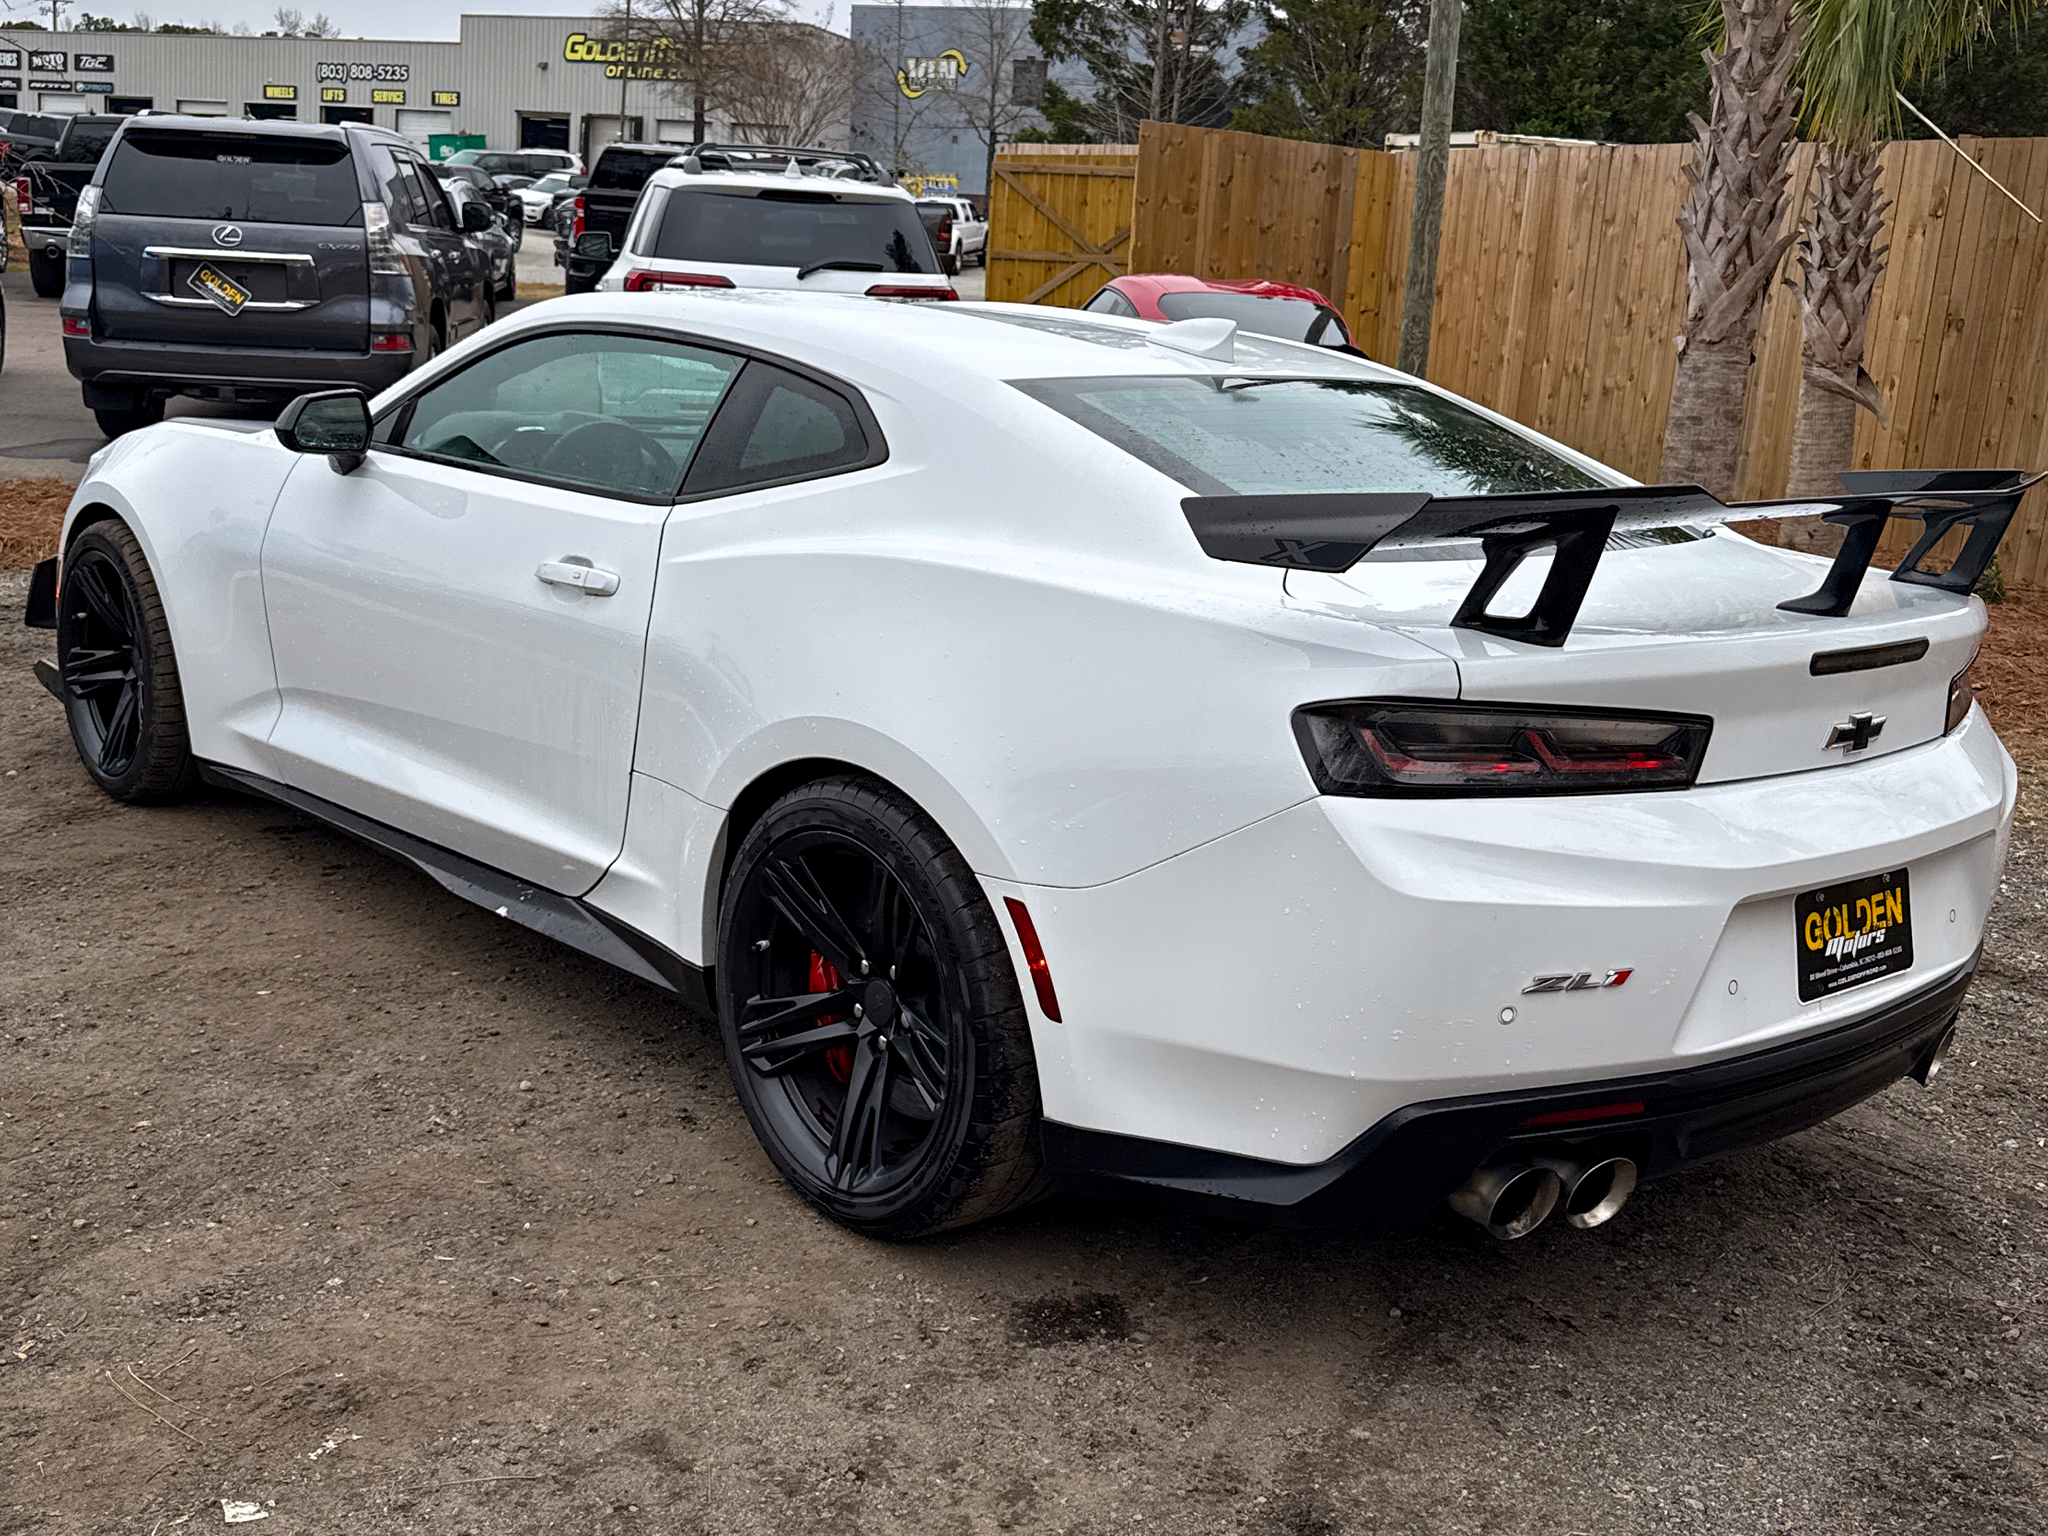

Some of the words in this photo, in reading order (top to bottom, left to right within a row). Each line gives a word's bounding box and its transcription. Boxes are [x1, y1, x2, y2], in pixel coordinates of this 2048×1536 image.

[317, 63, 348, 83] (803)
[350, 64, 409, 81] 808-5235
[266, 86, 295, 98] WHEELS
[323, 89, 345, 102] LIFTS
[373, 90, 405, 103] SERVICE
[434, 92, 458, 105] TIRES
[200, 269, 245, 305] GOLDEN
[1805, 887, 1903, 951] GOLDEN
[1825, 929, 1887, 962] Motors
[1521, 967, 1635, 995] ZL1
